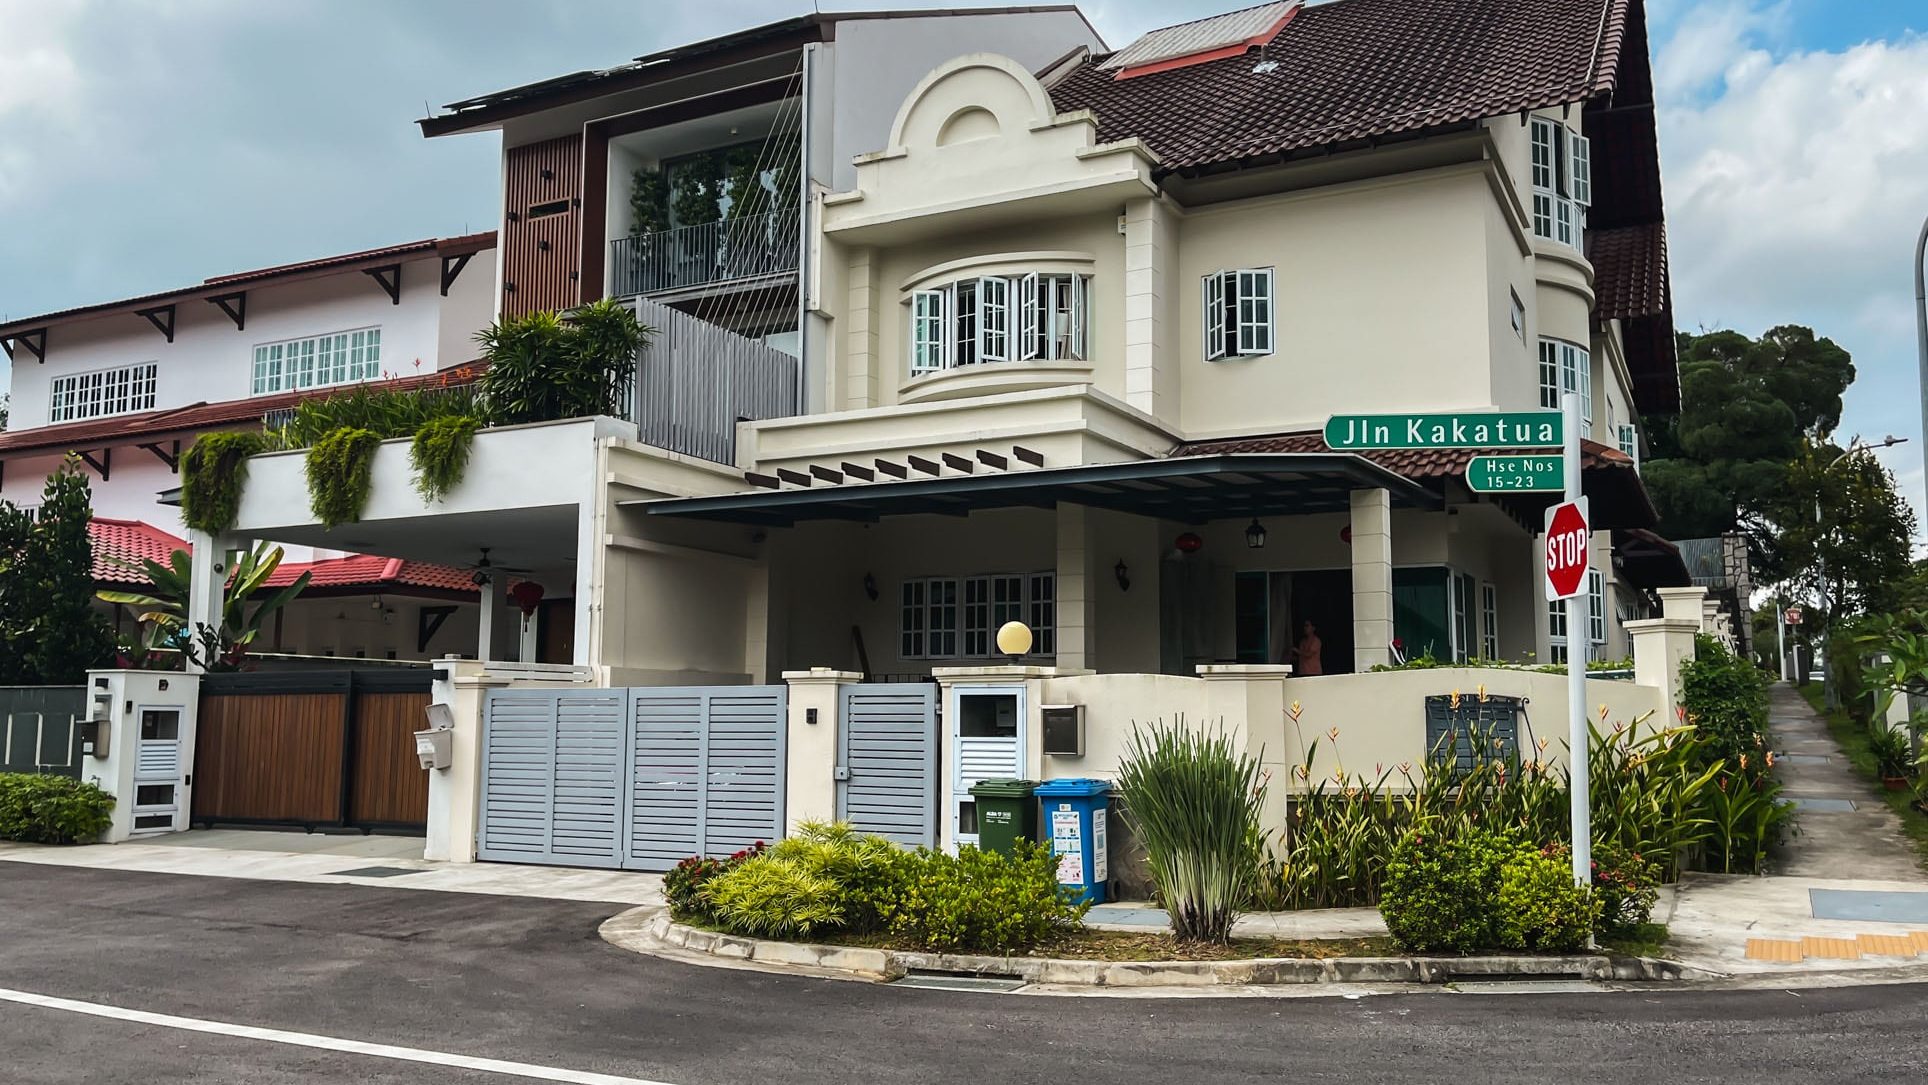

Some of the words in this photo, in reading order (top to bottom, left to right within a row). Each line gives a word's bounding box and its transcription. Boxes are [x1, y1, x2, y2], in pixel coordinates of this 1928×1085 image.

[1343, 420, 1389, 444] Jln
[1407, 418, 1553, 443] Kakatua
[1487, 460, 1515, 472] Hse
[1523, 459, 1553, 472] Nos
[1487, 476, 1534, 488] 15-23
[1547, 528, 1586, 571] STOP
